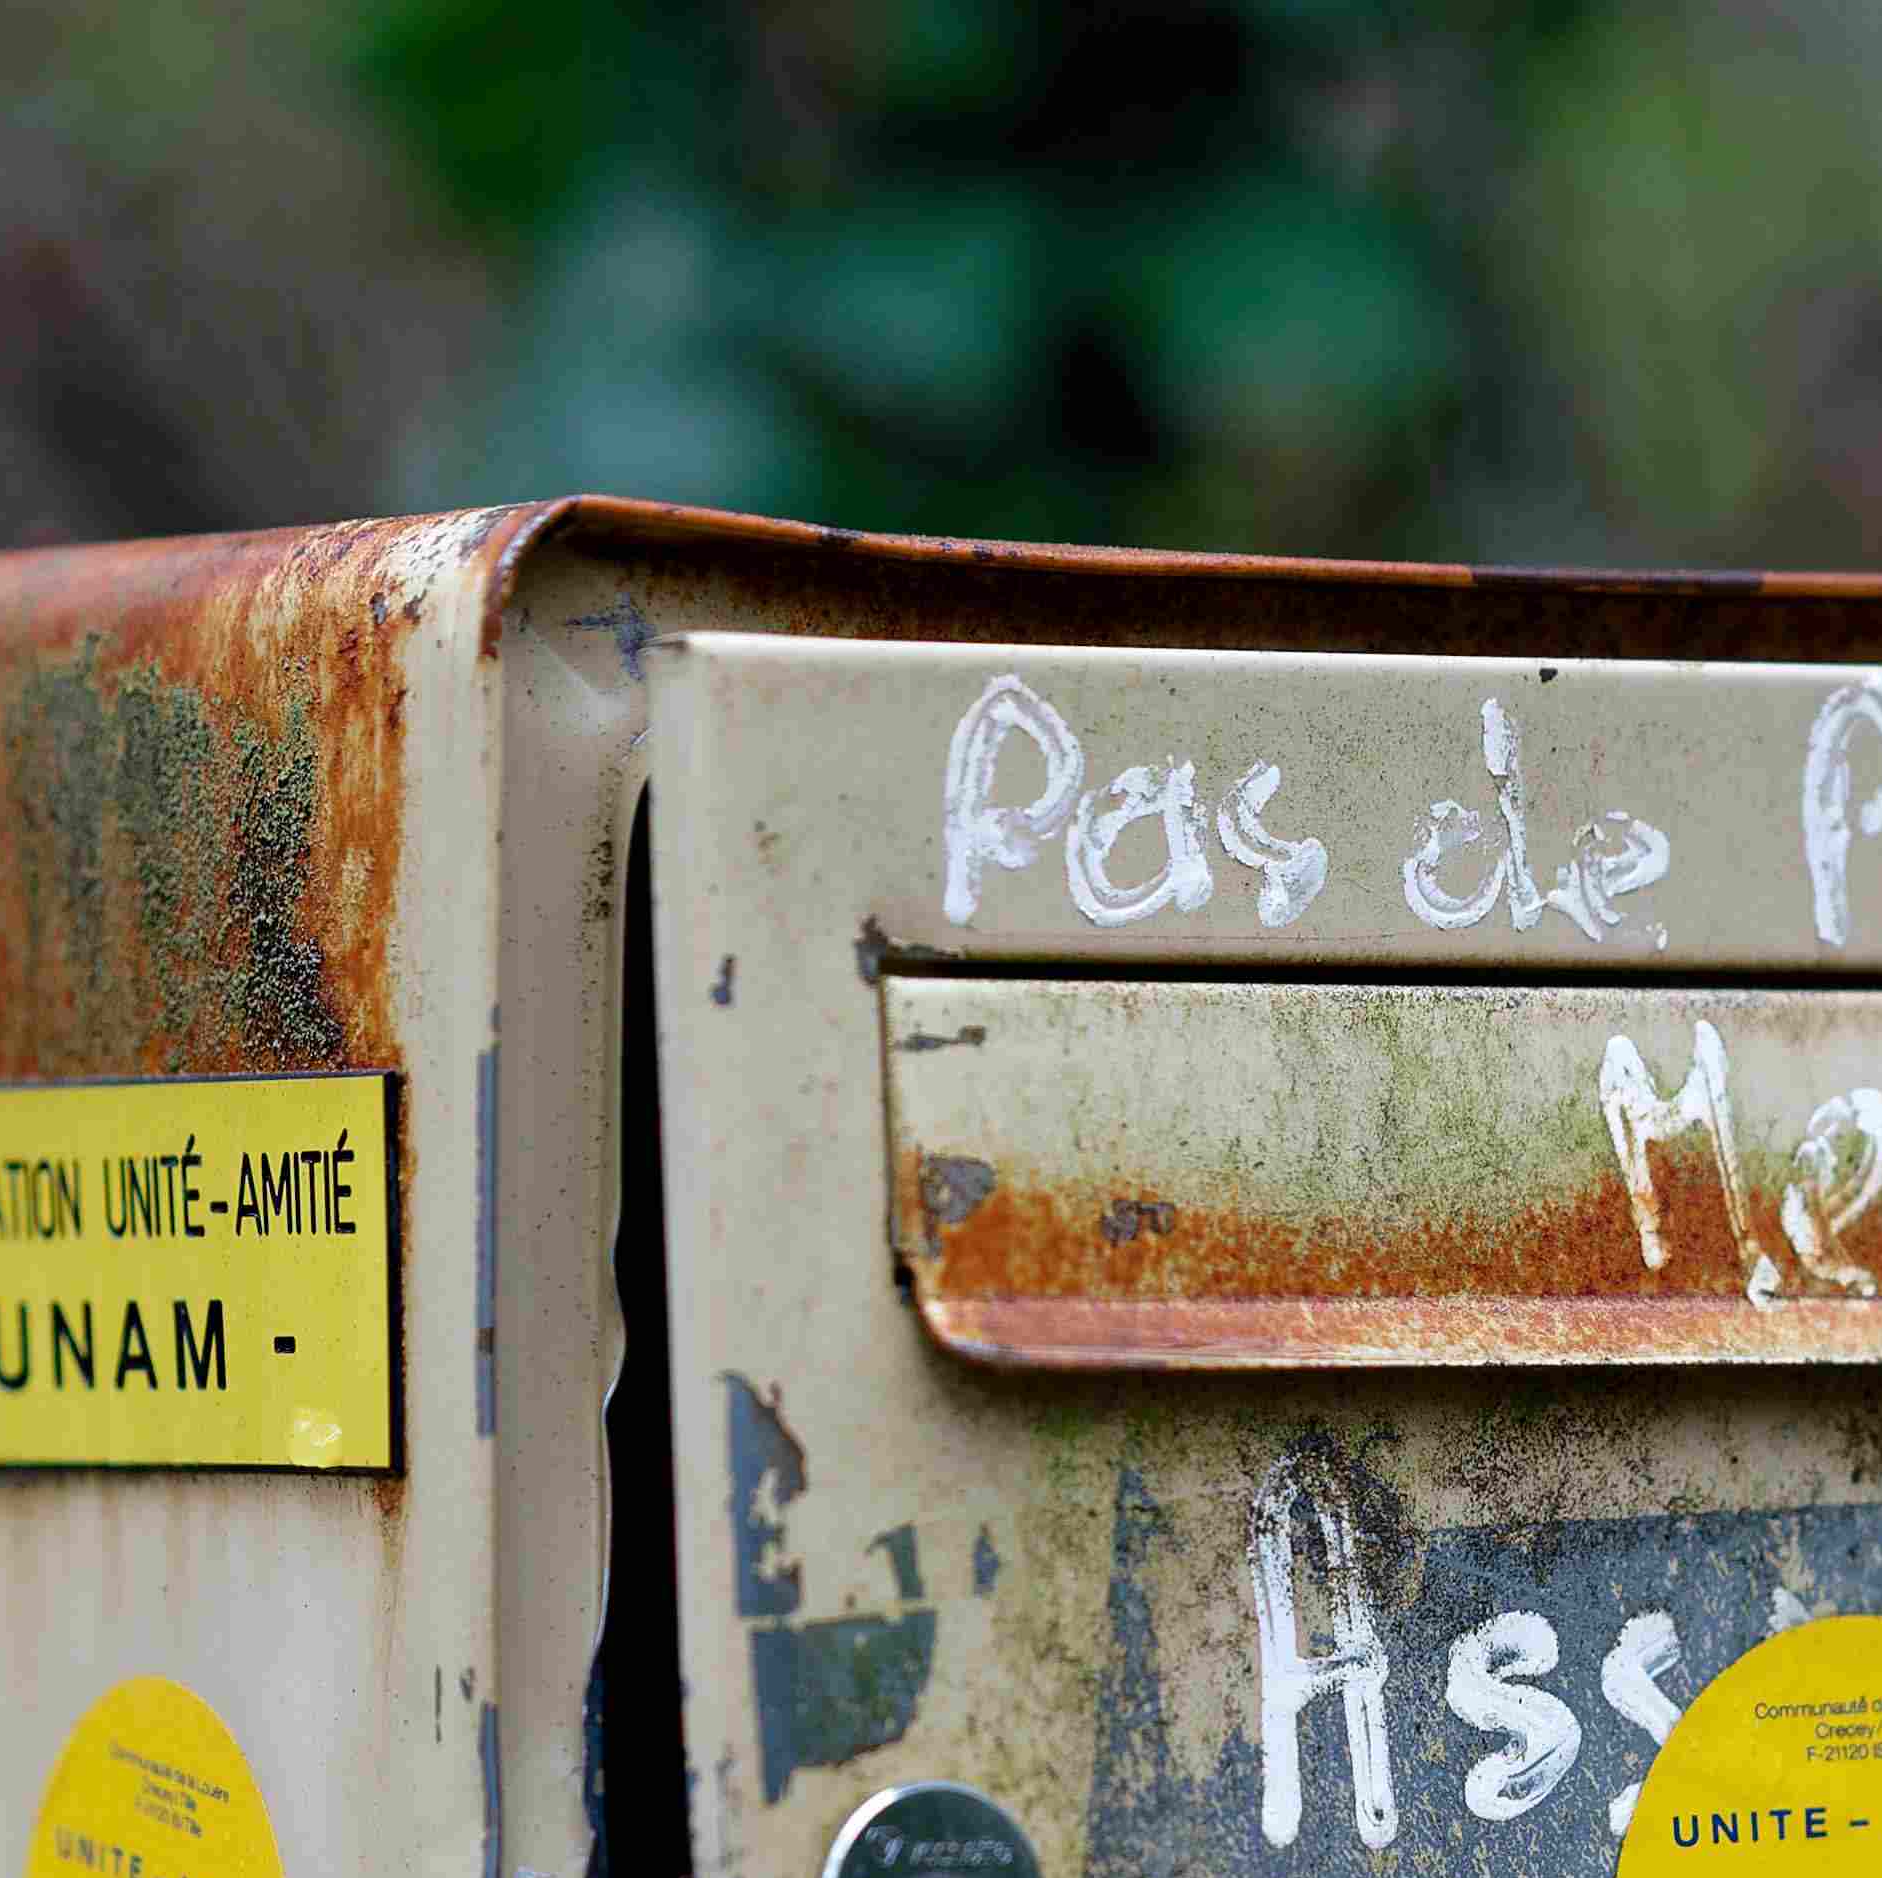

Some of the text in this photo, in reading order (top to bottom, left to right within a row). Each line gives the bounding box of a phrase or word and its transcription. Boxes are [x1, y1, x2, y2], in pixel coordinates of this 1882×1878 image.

[941, 672, 1327, 928] Pas
[1401, 696, 1671, 950] de
[1672, 1806, 1828, 1849] UNITE
